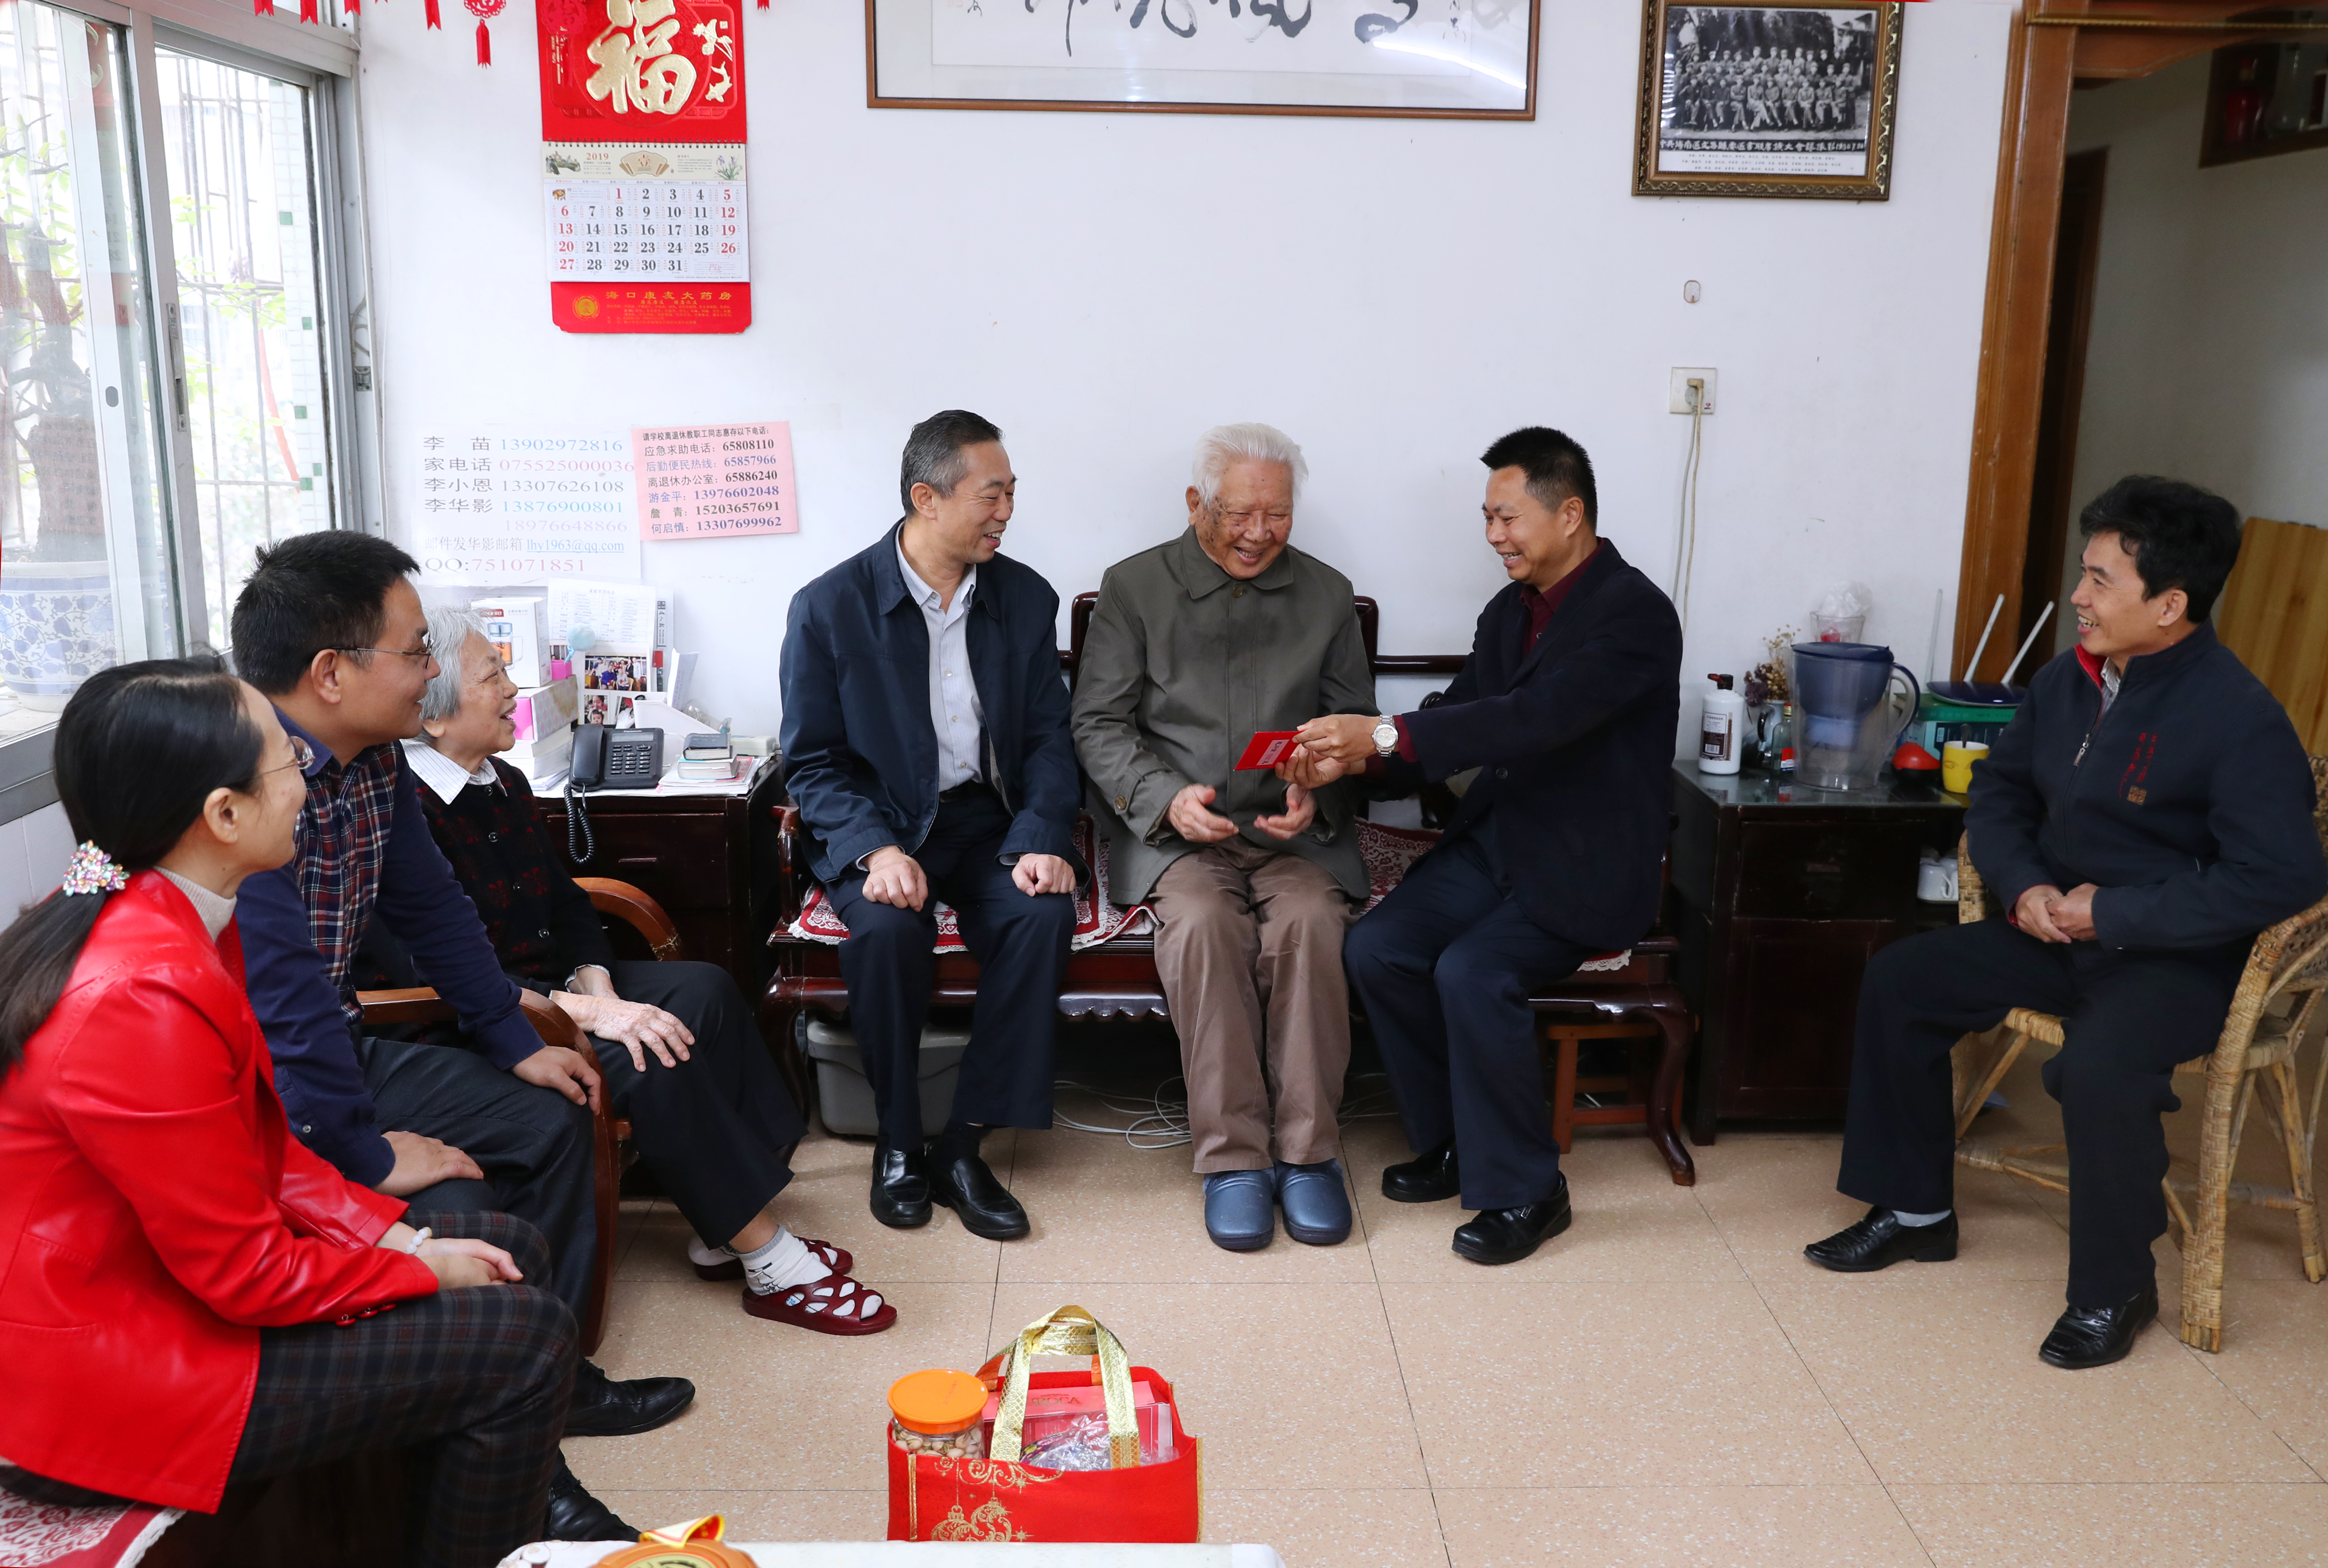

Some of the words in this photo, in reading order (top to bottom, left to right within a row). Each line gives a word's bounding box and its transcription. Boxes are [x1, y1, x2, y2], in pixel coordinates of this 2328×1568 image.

[586, 152, 609, 160] 2019
[617, 188, 621, 199] 1
[643, 189, 649, 199] 2
[670, 189, 676, 200] 3
[697, 189, 704, 200] 4
[724, 189, 730, 200] 5
[561, 206, 568, 216] 6
[589, 206, 595, 216] 7
[616, 206, 623, 217] 8
[643, 207, 650, 216] 9
[668, 207, 681, 217] 10
[695, 207, 707, 217] 11
[722, 207, 735, 218] 12
[560, 224, 573, 234] 13
[587, 224, 600, 234] 14
[614, 224, 627, 234] 15
[642, 224, 655, 235] 16
[668, 225, 681, 235] 17
[696, 225, 708, 236] 18
[722, 225, 735, 235] 19
[560, 241, 574, 252] 20
[587, 242, 600, 252] 21
[614, 242, 628, 252] 22
[641, 242, 655, 252] 23
[668, 243, 682, 253] 24
[695, 243, 708, 253] 25
[721, 243, 736, 253] 26
[560, 259, 574, 269] 27
[588, 260, 602, 270] 28
[615, 260, 629, 270] 29
[642, 260, 656, 270] 30
[668, 260, 681, 270] 31
[606, 291, 732, 300] 海口康友大药房
[424, 436, 444, 450] 李
[471, 437, 491, 451] 苗
[501, 439, 622, 451] 13902972816
[645, 443, 715, 456] 应急求助电话：
[723, 439, 774, 451] 65808110
[424, 457, 492, 472] 家电话
[500, 460, 634, 472] 075525000036
[646, 459, 716, 472] 后勤便民热线：
[724, 455, 776, 467] 65857966
[424, 478, 492, 492] 李小恩
[502, 480, 624, 492] 13307626108
[648, 474, 718, 488] 离退休办公室：
[726, 470, 777, 482] 65886240
[694, 486, 779, 500] 13976602048
[425, 498, 493, 512] 李华影
[503, 501, 623, 513] 13876900801
[696, 501, 780, 516] 15203657691
[505, 520, 627, 532] 18976648866
[697, 516, 781, 531] 13307699962
[425, 537, 522, 551] 邮件发华影邮箱
[527, 539, 624, 552] lhy1963@qq.com
[1031, 1396, 1081, 1406] ROCA
